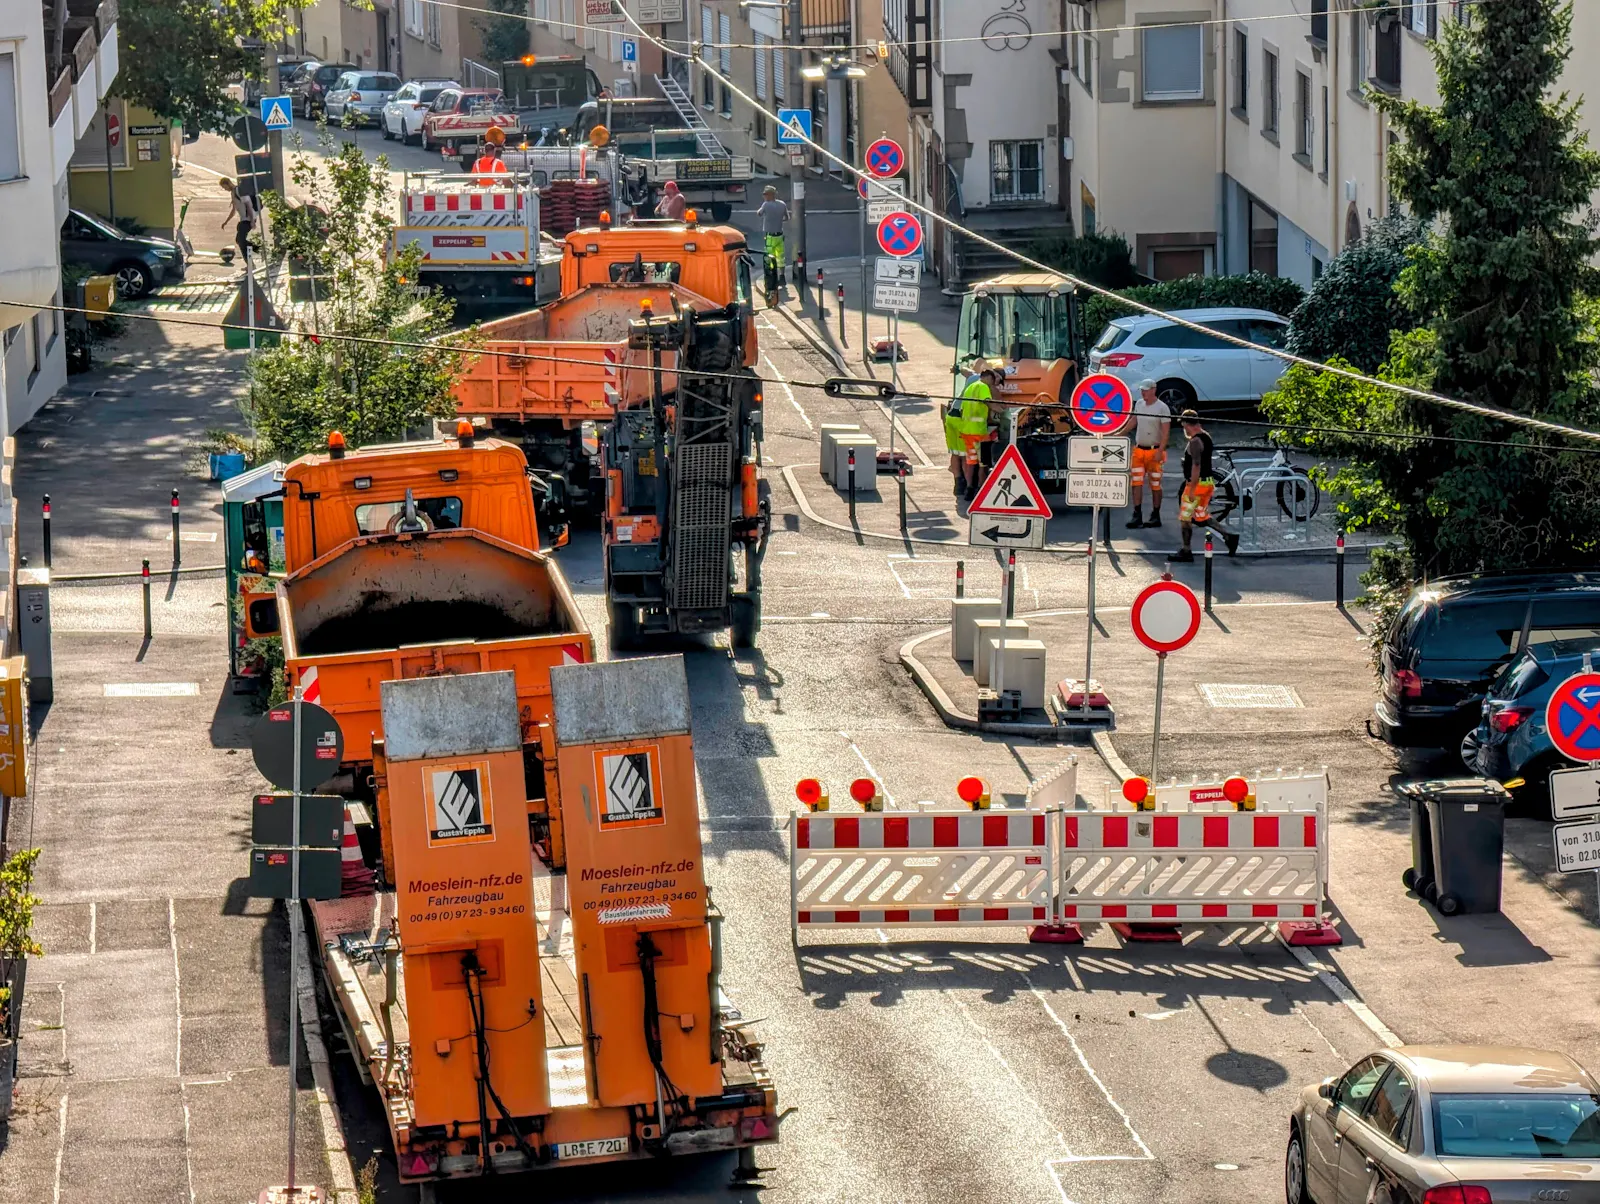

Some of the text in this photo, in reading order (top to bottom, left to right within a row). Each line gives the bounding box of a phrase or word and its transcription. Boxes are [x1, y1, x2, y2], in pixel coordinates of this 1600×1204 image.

[625, 43, 633, 58] P
[1070, 490, 1078, 498] bis
[1112, 492, 1124, 500] 22h
[1562, 836, 1578, 846] von
[1560, 854, 1574, 864] bis
[581, 860, 694, 881] Moeslein-nfz.de
[408, 872, 523, 894] Moeslein-nfz.de
[600, 879, 676, 894] Fahrzeugbau
[428, 892, 504, 907] Fahrzeugbau
[598, 1140, 622, 1153] 720
